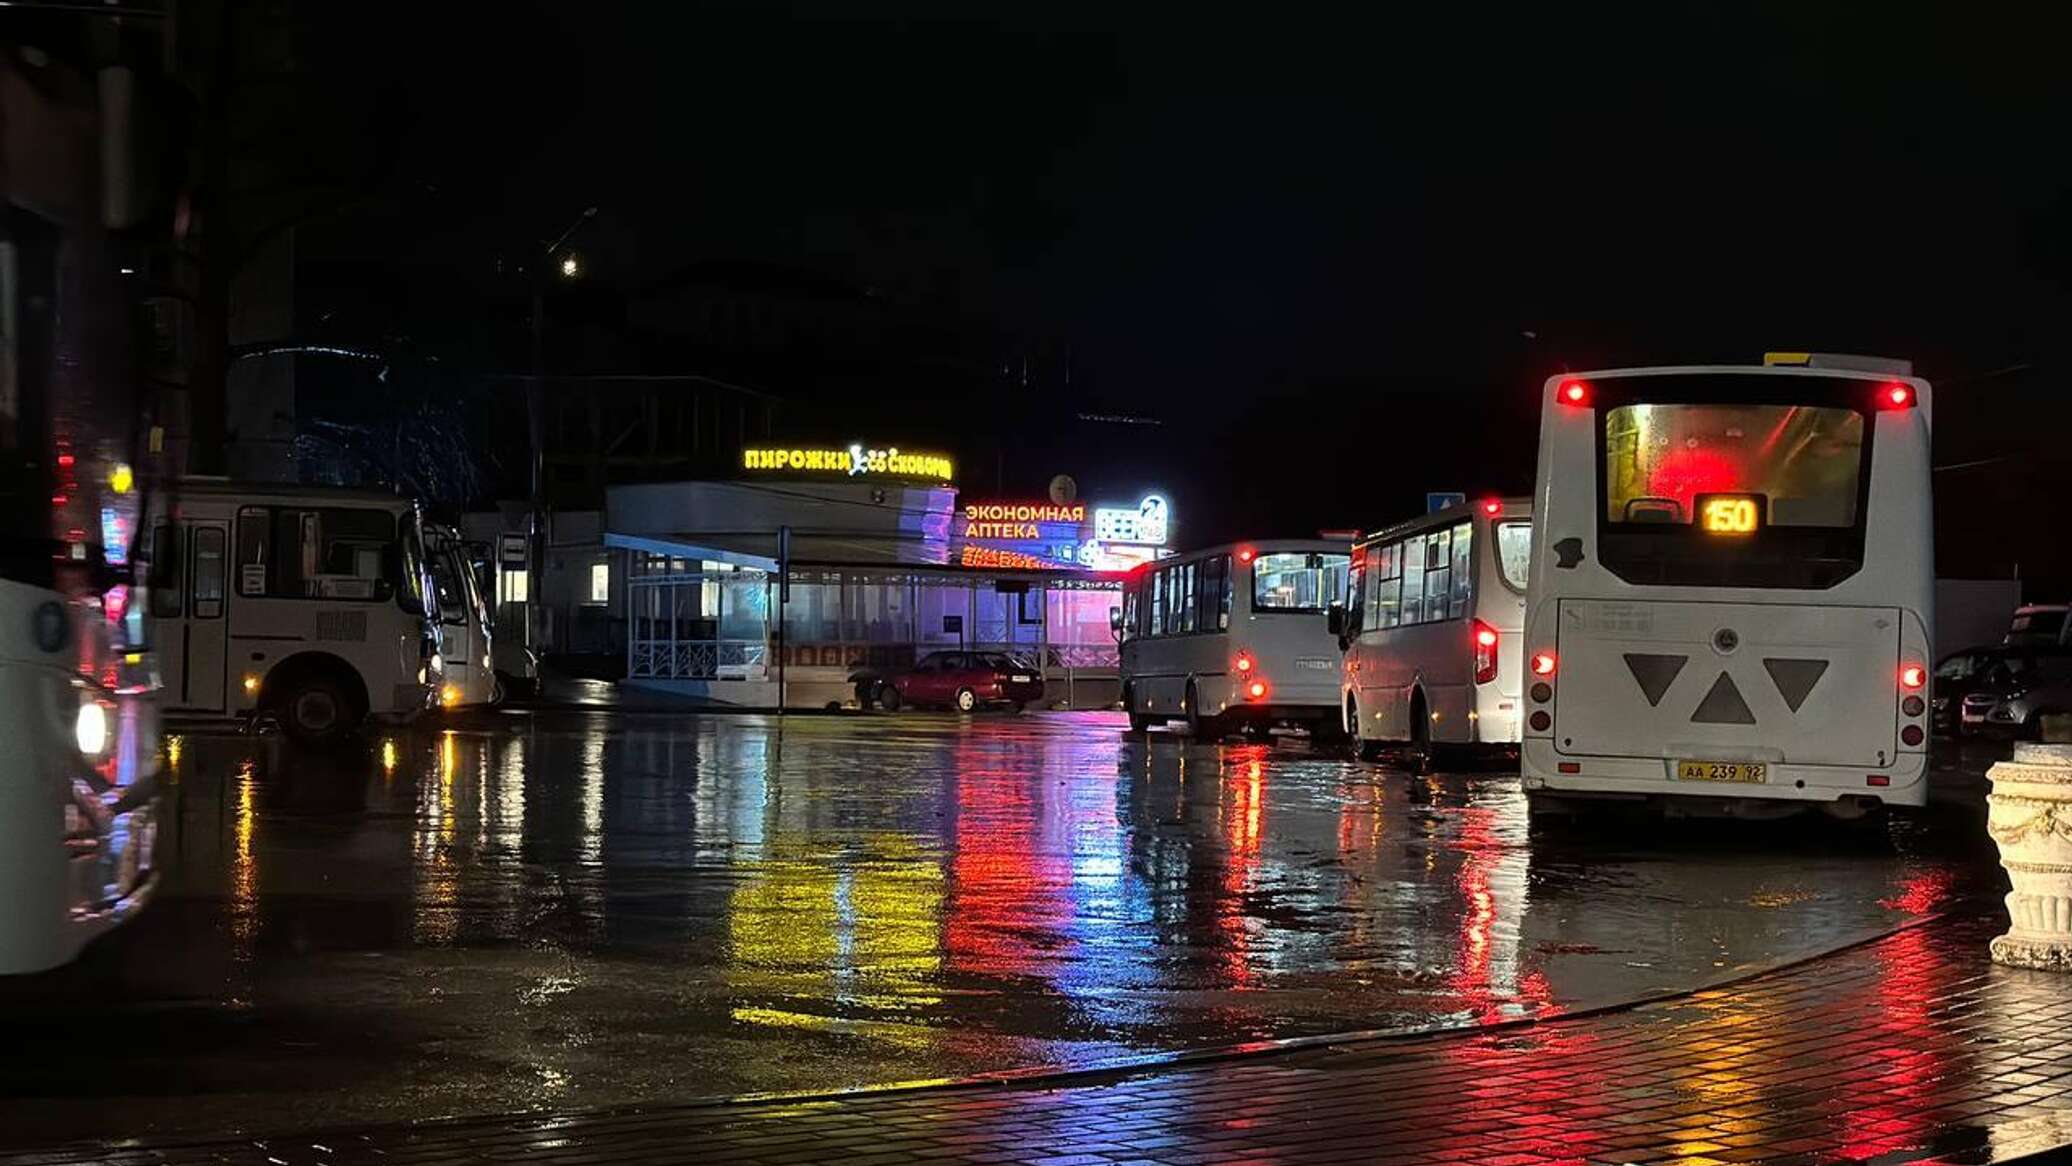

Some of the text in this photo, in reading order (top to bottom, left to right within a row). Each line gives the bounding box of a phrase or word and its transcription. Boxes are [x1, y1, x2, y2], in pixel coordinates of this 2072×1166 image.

[744, 450, 850, 469] ПИРОЖКИ
[965, 505, 1084, 521] ЭКОНОМНАЯ
[1706, 499, 1757, 531] 150
[965, 522, 1039, 538] АПТЕКА
[1710, 765, 1737, 779] 239
